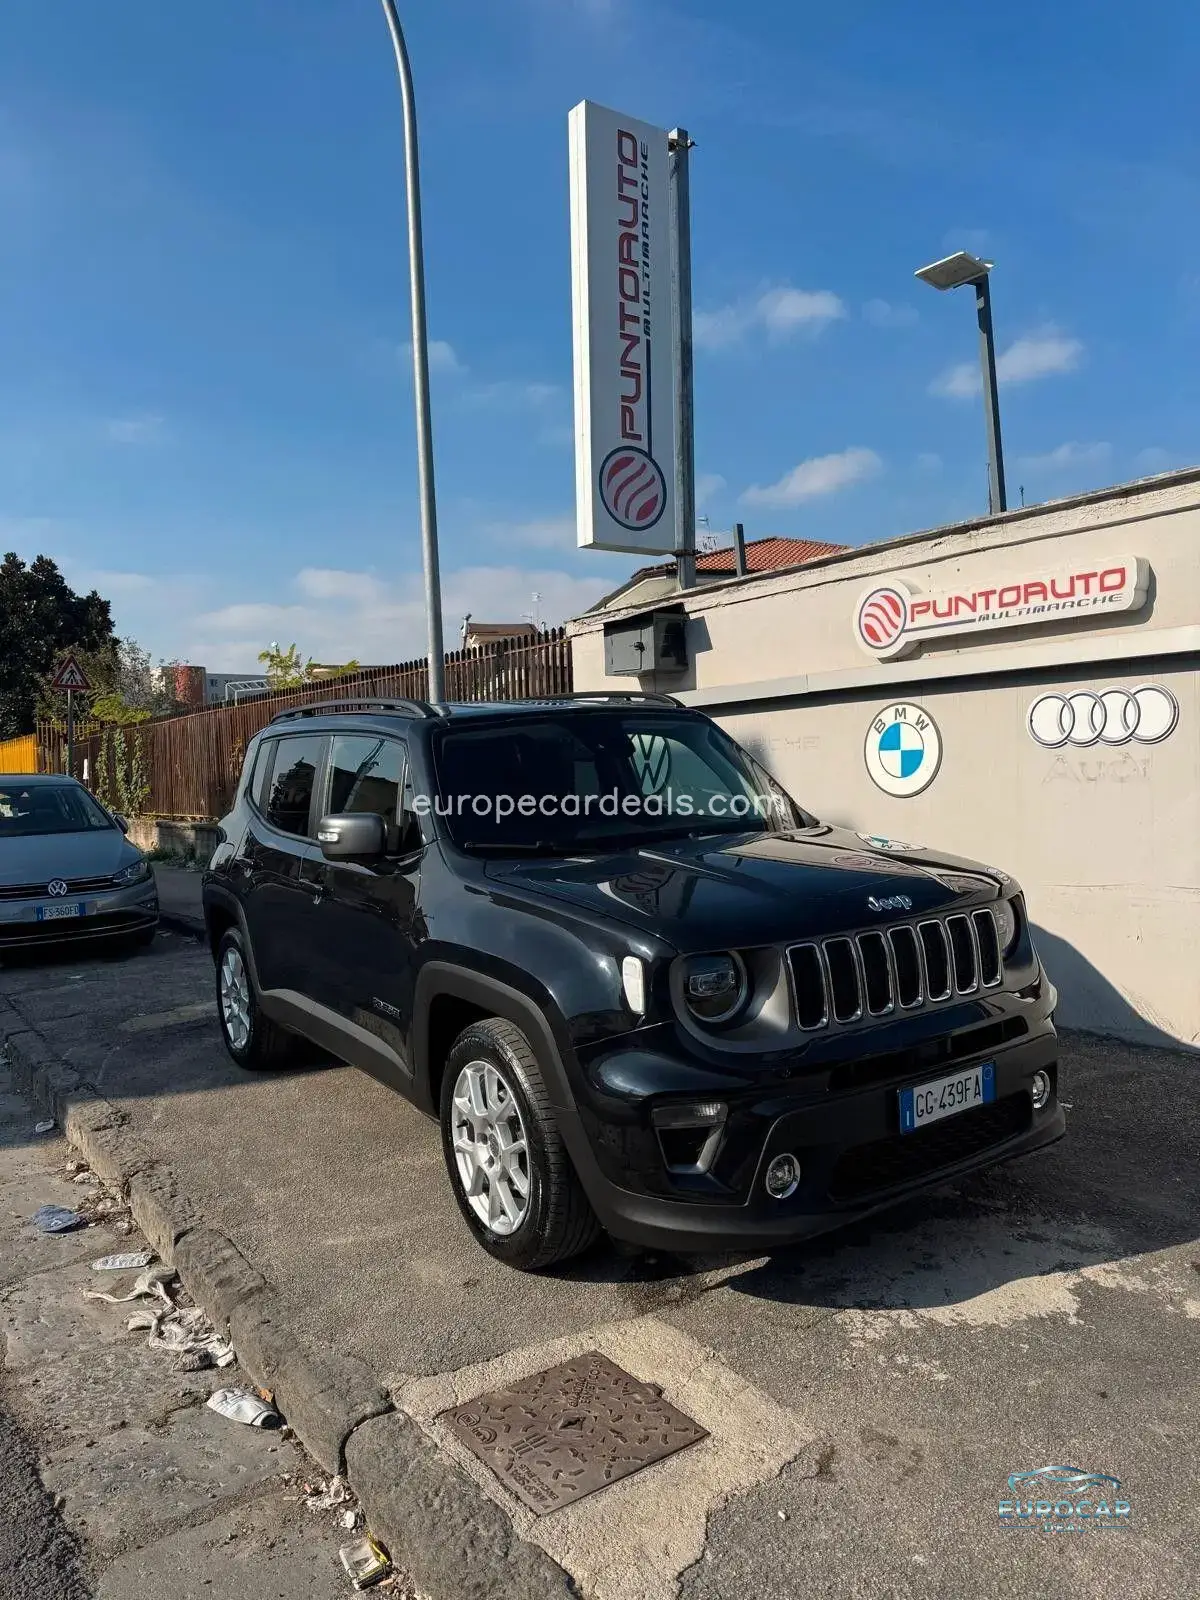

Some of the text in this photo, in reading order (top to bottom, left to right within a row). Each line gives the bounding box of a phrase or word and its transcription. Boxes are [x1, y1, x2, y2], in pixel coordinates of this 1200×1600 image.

[640, 140, 652, 340] MULTIMARCHE
[617, 128, 642, 442] PUNTOAUTO
[910, 567, 1126, 623] PUNTOAUTO
[977, 593, 1123, 623] MULTIMARCHE
[873, 707, 930, 735] BMW
[867, 895, 913, 911] Jeep
